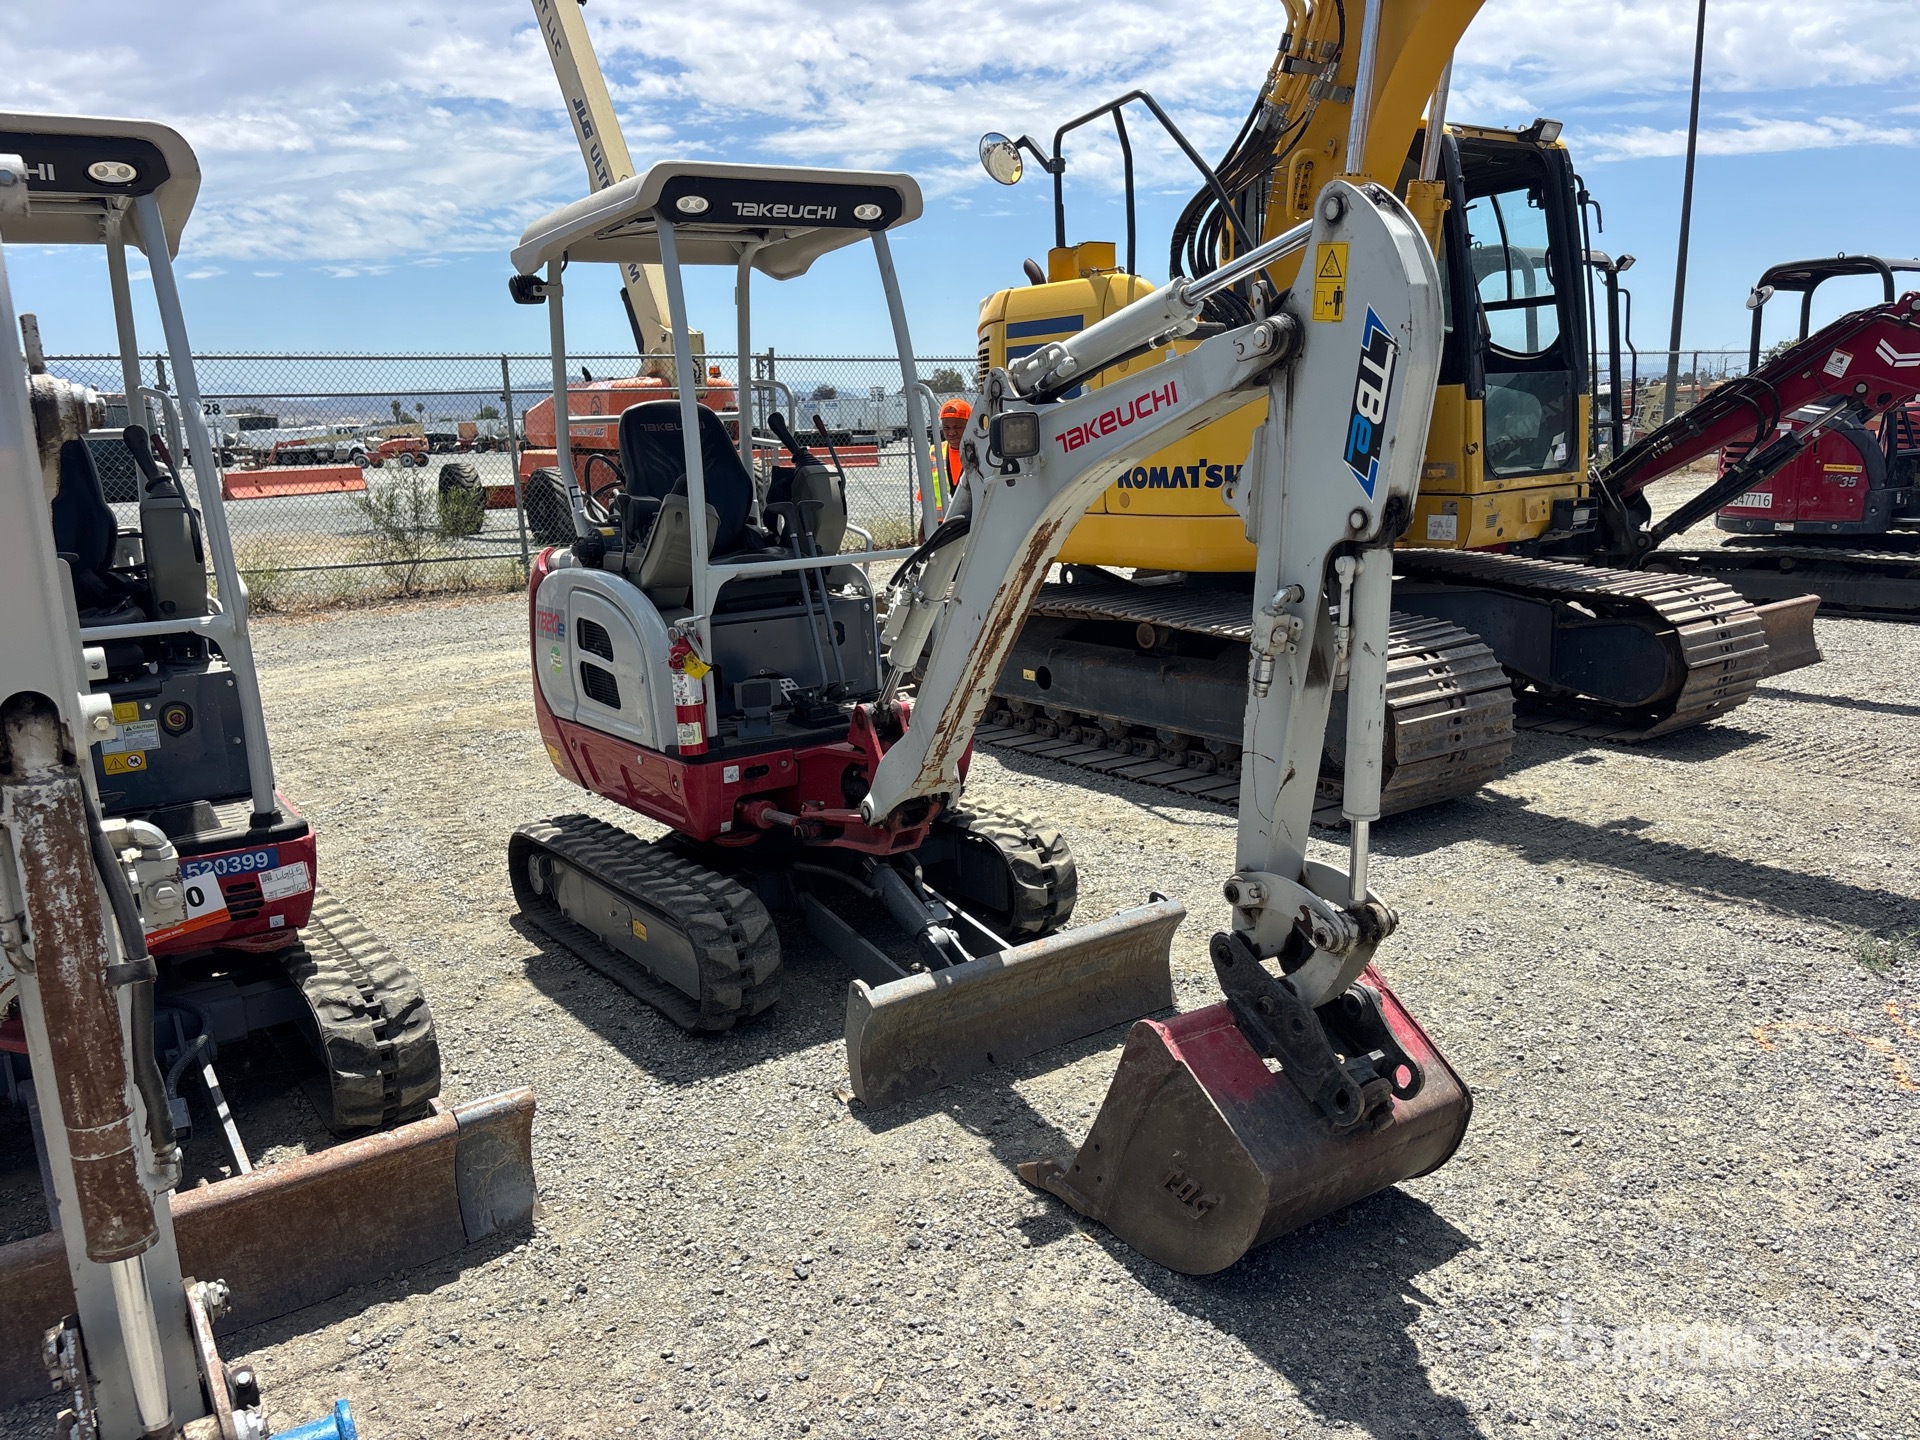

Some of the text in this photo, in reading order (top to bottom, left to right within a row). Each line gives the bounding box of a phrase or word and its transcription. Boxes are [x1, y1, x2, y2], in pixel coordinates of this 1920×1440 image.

[546, 15, 562, 57] LLC
[572, 98, 593, 141] JLG
[731, 201, 838, 220] TAKEUCHI
[203, 404, 221, 416] 28
[1055, 380, 1178, 453] TAKEUCHI
[186, 851, 269, 878] 520399
[186, 886, 205, 907] 0
